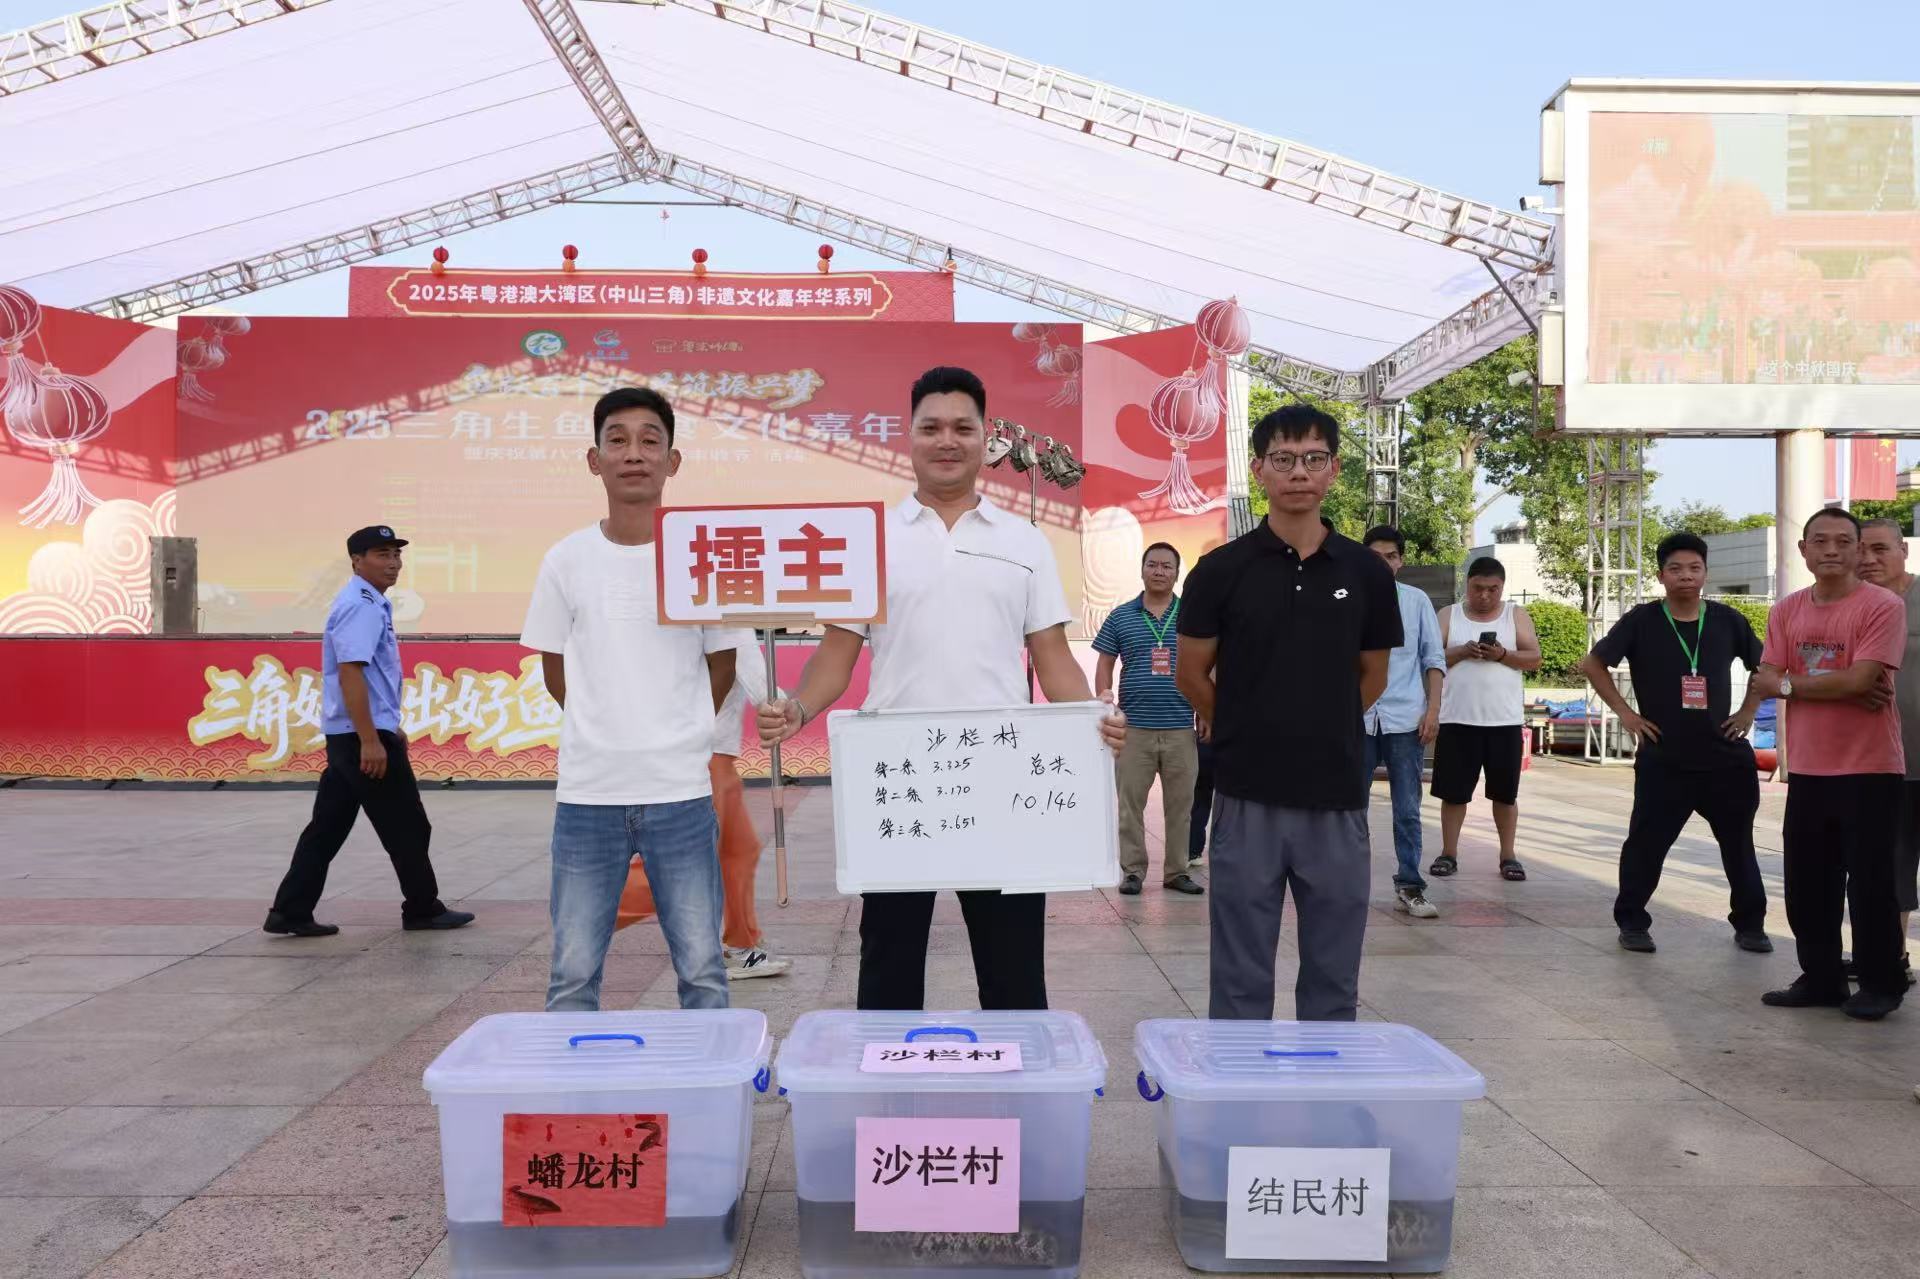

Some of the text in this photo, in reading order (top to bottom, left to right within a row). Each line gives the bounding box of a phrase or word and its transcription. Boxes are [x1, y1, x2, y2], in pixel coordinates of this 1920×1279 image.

[408, 284, 873, 307] 2025年粤港澳大湾区(中山三角)非遗文化嘉年华系列
[1763, 360, 1857, 377] 这个中秋国庆
[689, 523, 853, 607] 擂主
[927, 722, 1021, 752] 沙栏村
[874, 757, 974, 778] 第一条 3.325
[875, 785, 971, 806] 第二条 3.170
[1010, 790, 1077, 816] 10.146
[940, 815, 976, 832] 3.651
[879, 1047, 1007, 1063] 沙栏村
[526, 1150, 645, 1191] 蟠龙村
[871, 1143, 1005, 1188] 沙栏村
[1246, 1175, 1371, 1218] 结民村
